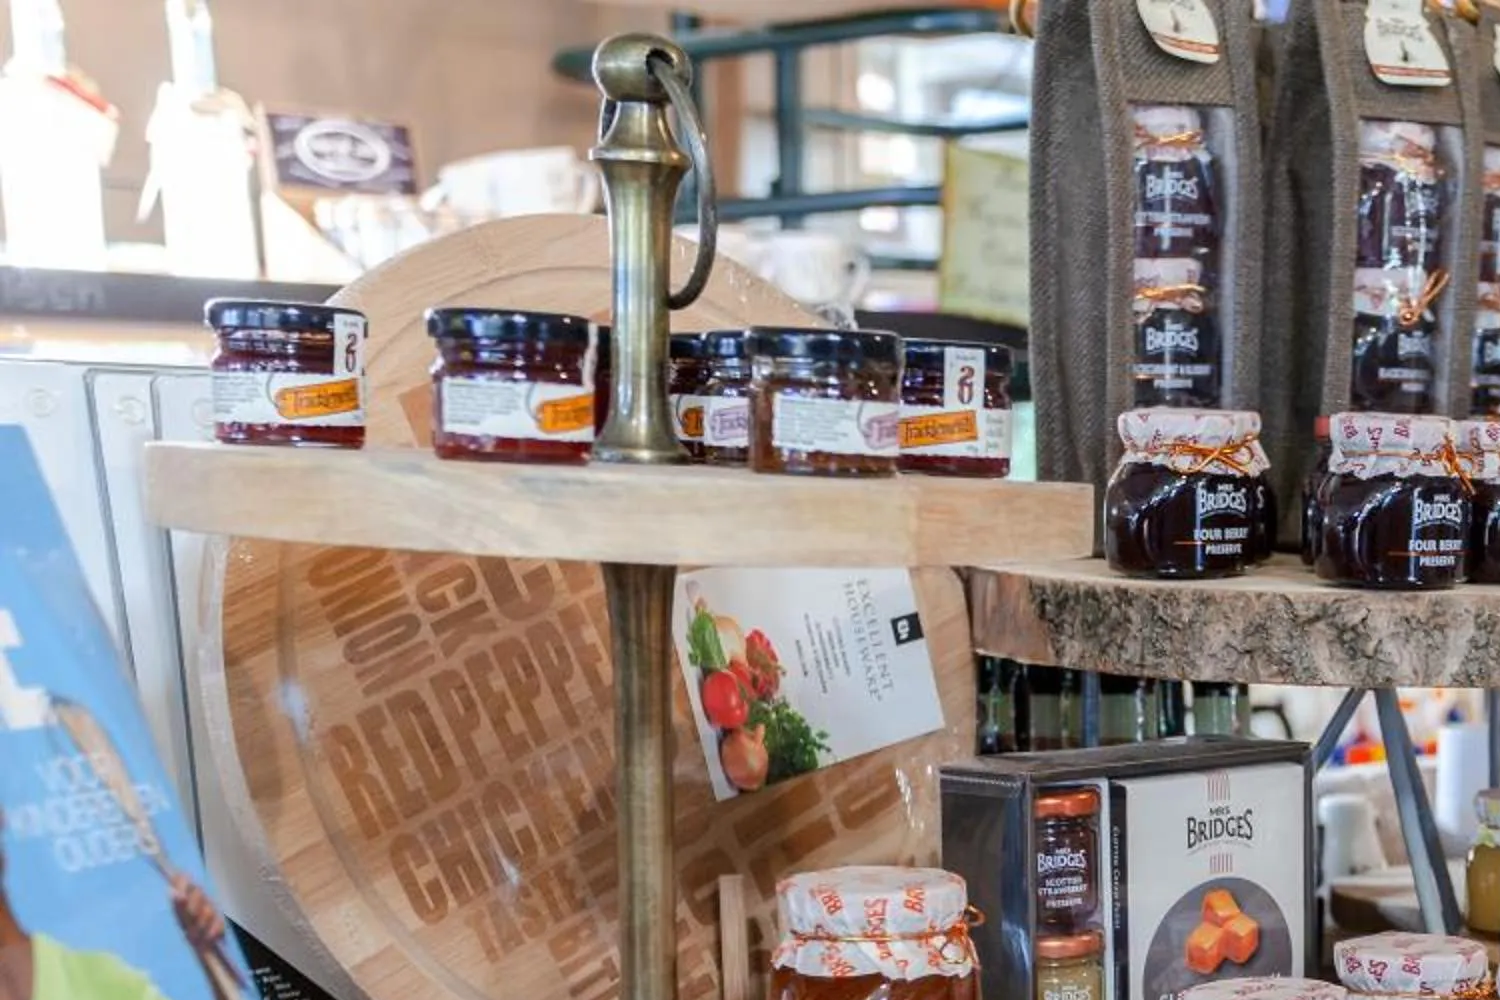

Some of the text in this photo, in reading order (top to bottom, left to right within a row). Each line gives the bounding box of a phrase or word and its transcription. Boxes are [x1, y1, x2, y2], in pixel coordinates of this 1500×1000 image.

[1199, 486, 1248, 514] BRIDGES
[1414, 499, 1463, 524] BRIDGES
[1194, 527, 1223, 542] FOUR
[1409, 540, 1436, 551] FOUR
[856, 577, 895, 692] EXCELLENT
[324, 688, 463, 842] RED
[428, 600, 614, 782] PEPPE
[1187, 808, 1253, 849] BRIDGES
[1038, 849, 1087, 873] BRIDGES
